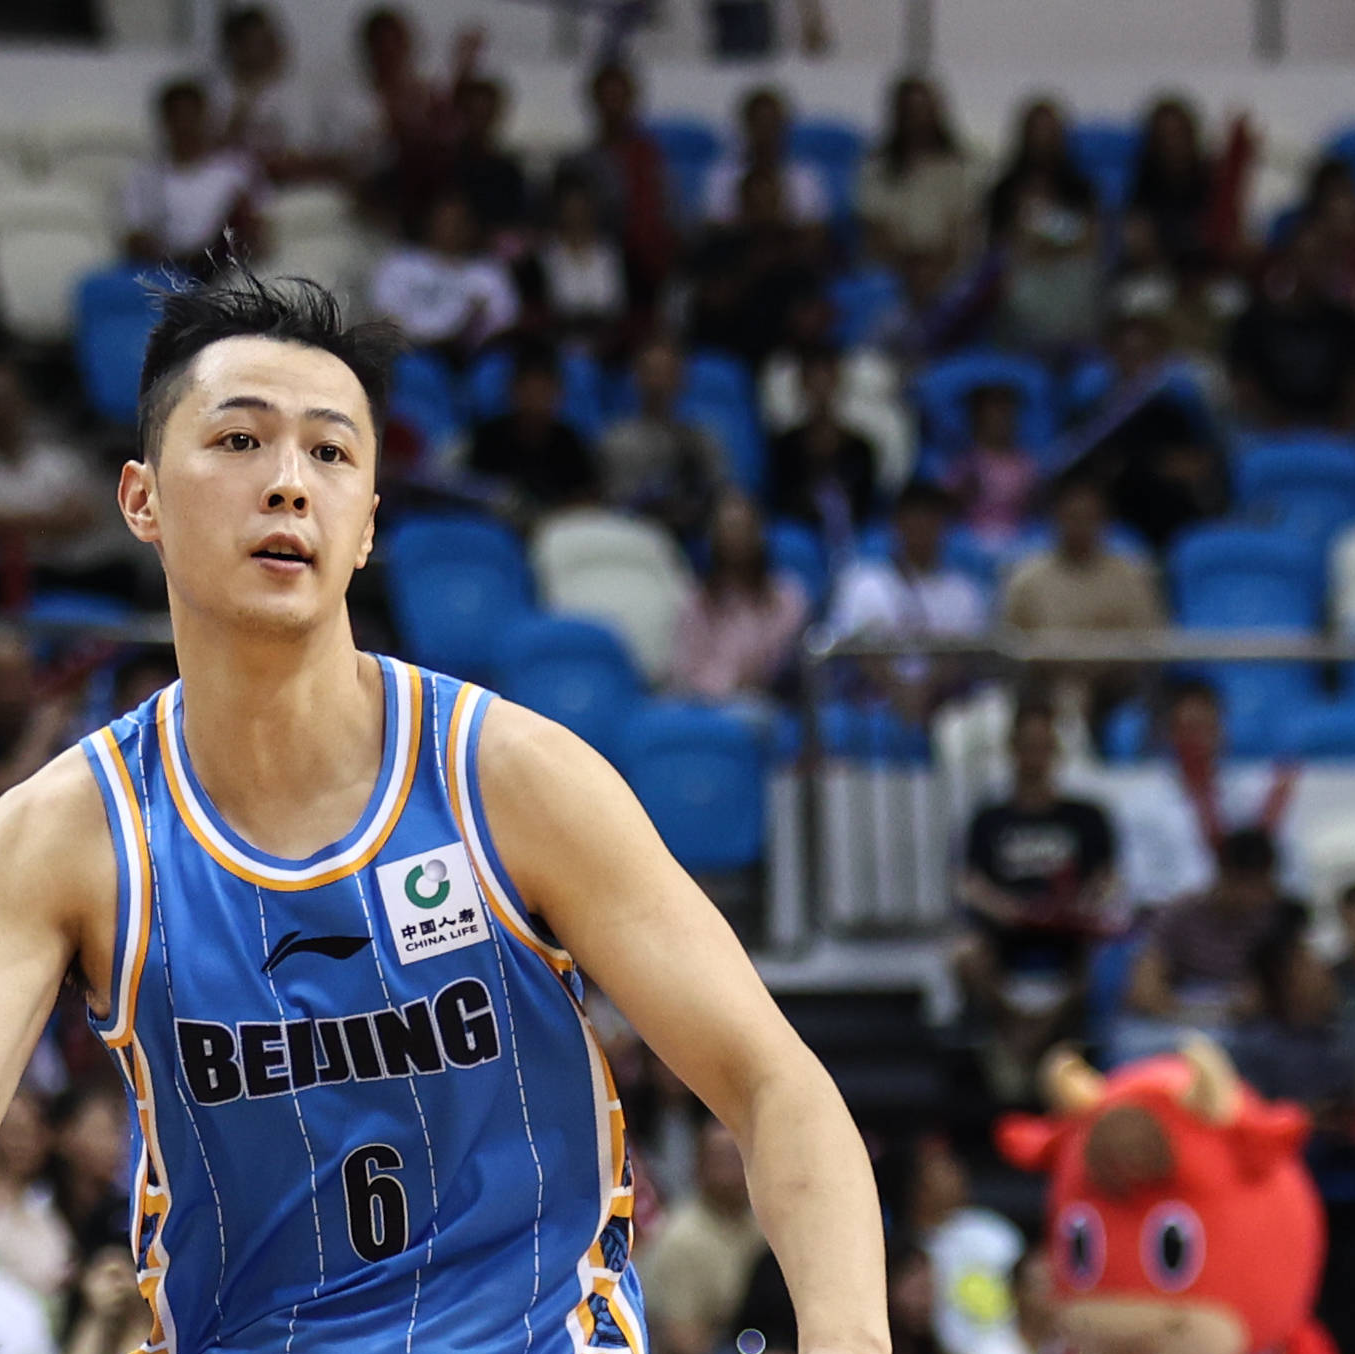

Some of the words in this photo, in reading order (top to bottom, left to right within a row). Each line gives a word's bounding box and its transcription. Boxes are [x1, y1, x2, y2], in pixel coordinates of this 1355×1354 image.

[401, 908, 475, 940] 中国人寿
[405, 934, 447, 952] CHINA
[449, 924, 478, 940] LIFE
[173, 976, 501, 1106] BEIJING
[342, 1142, 409, 1264] 6
